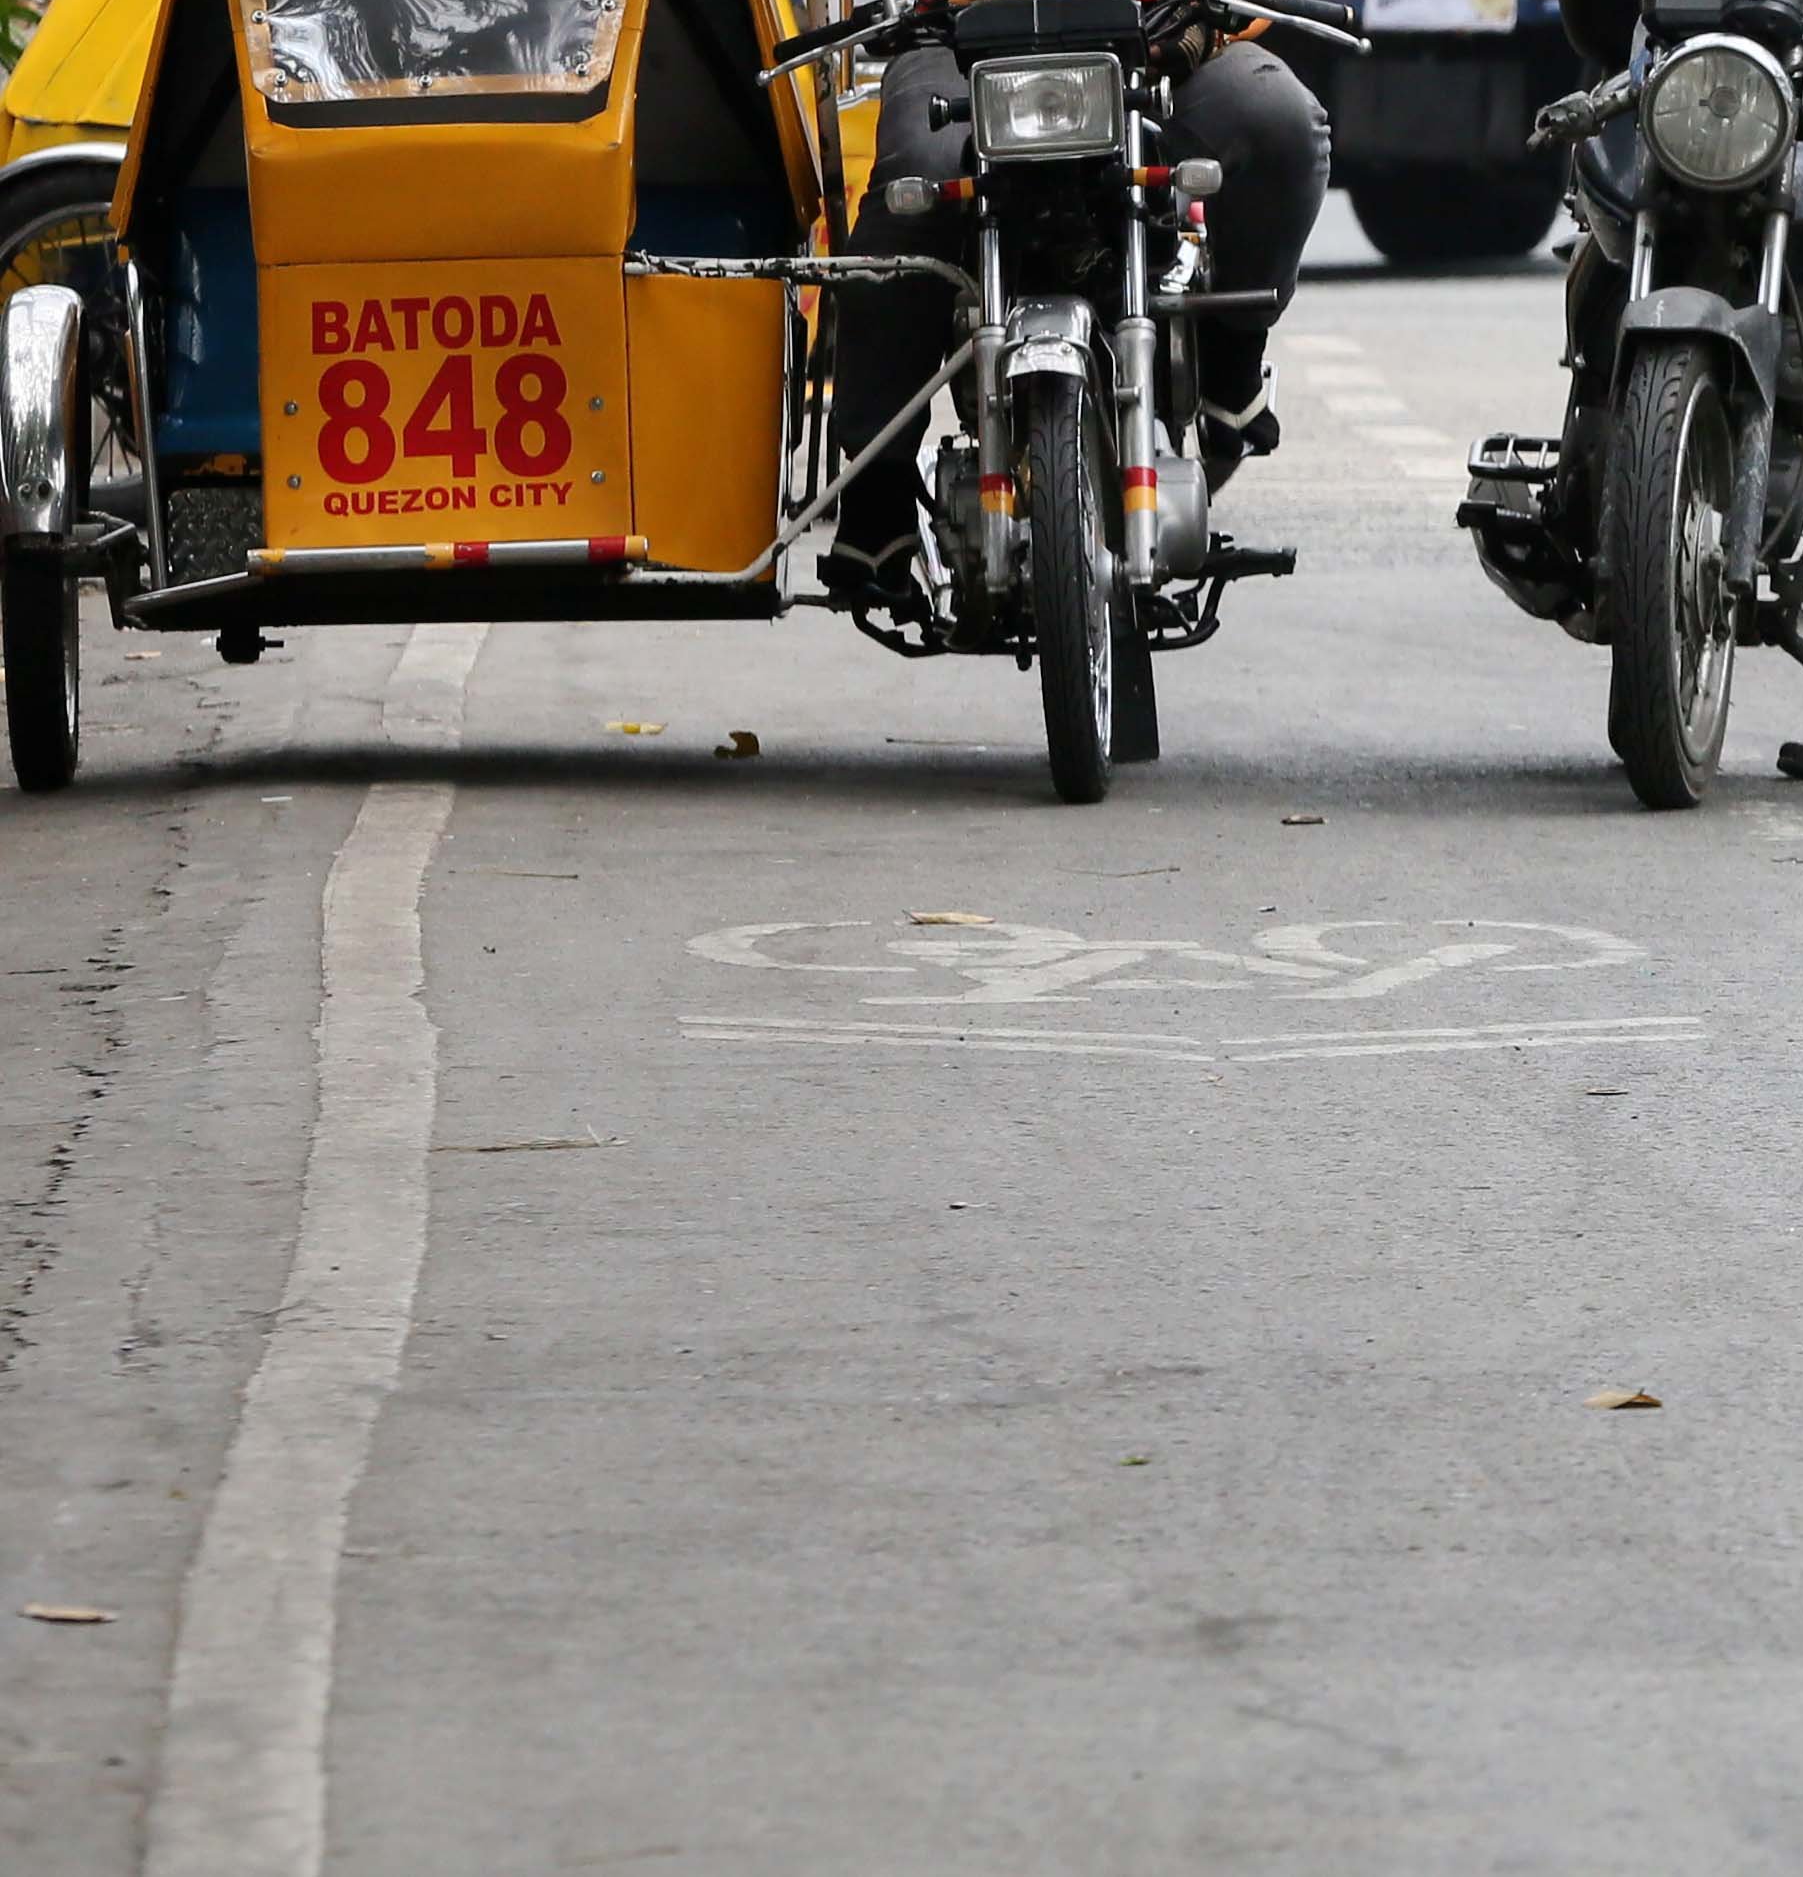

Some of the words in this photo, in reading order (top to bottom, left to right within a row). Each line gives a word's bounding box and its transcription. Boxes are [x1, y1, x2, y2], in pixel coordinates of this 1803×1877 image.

[311, 294, 562, 355] BATODA
[317, 354, 573, 486] 848
[324, 485, 477, 518] QUEZON
[489, 481, 575, 508] CITY
